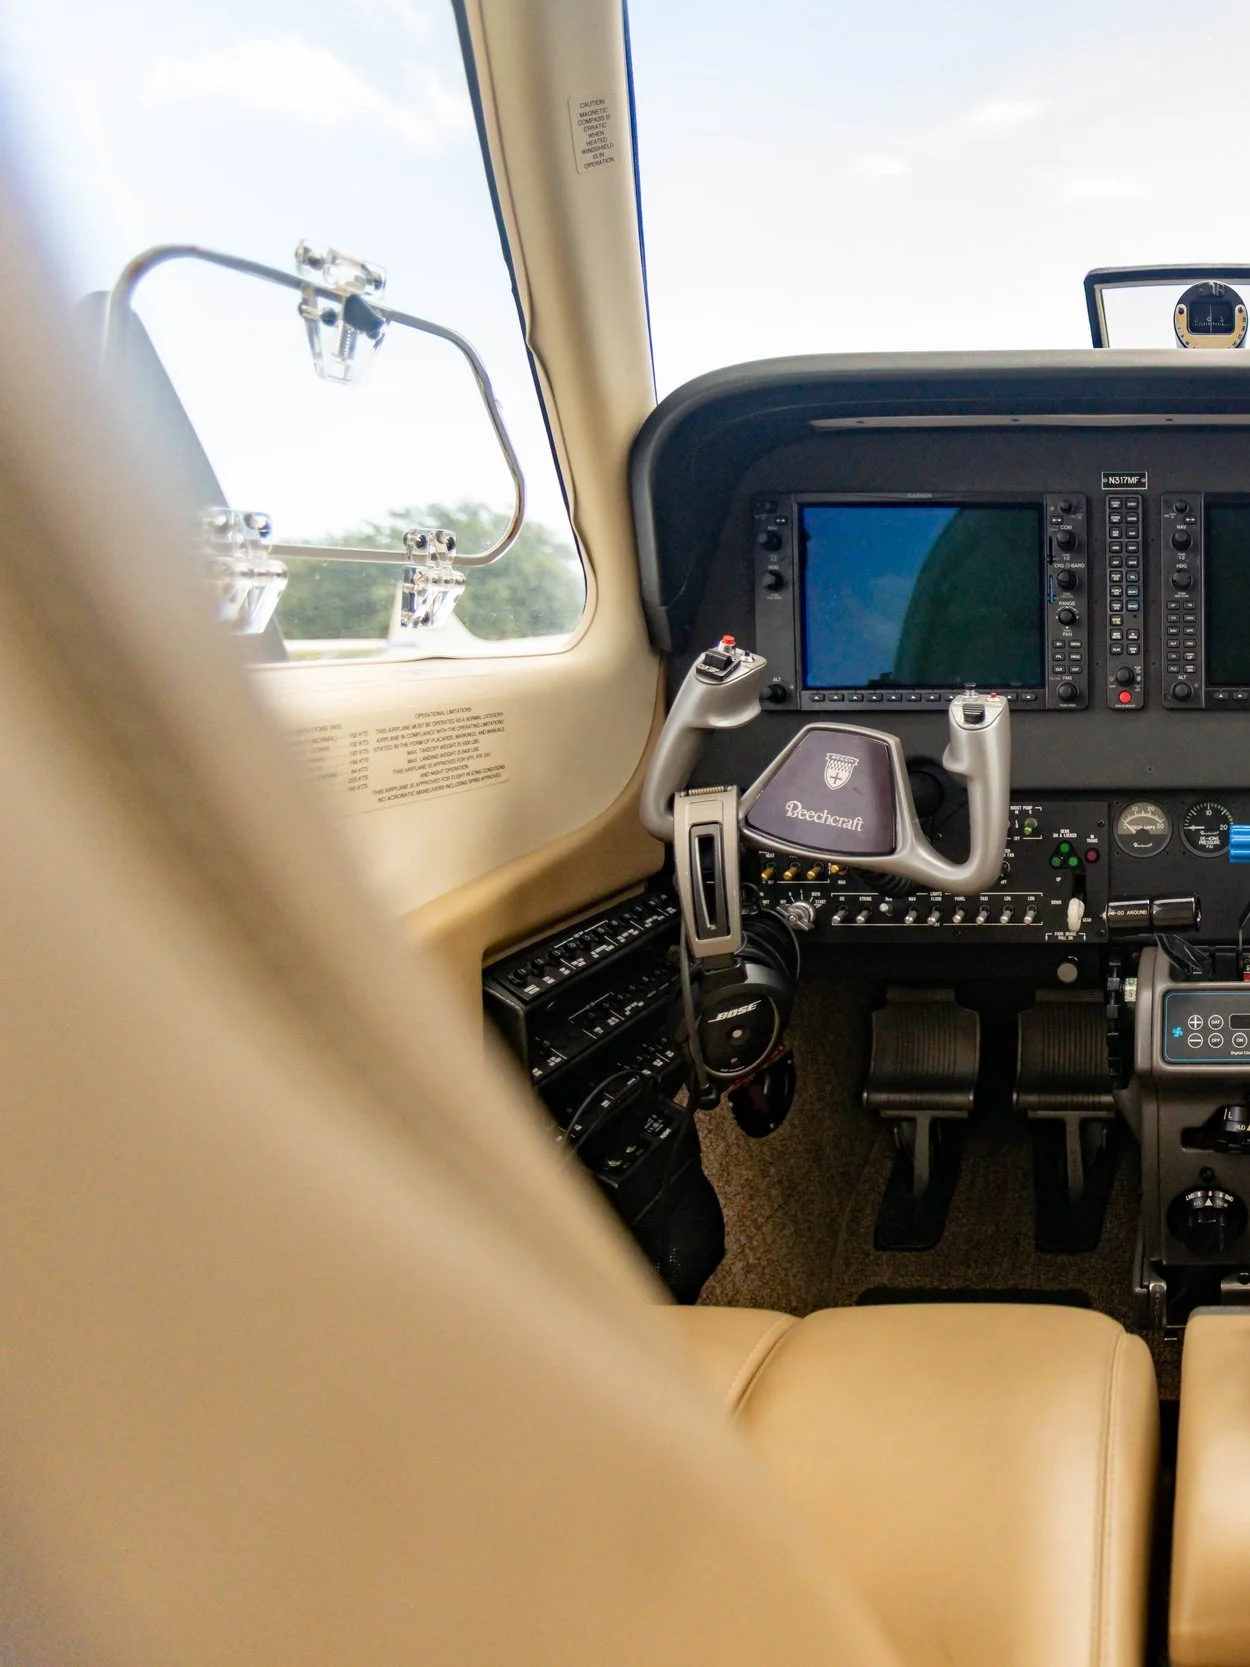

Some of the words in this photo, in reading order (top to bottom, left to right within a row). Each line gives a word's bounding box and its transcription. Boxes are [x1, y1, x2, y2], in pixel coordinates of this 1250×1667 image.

[580, 99, 605, 108] CAUTION
[579, 107, 608, 118] MAGNETIC
[577, 115, 605, 126] COMPASS
[584, 122, 607, 132] ERRATIC
[586, 137, 607, 147] HEATED
[581, 143, 614, 155] WINDSHIELD
[584, 157, 614, 169] OPERATION
[1108, 476, 1140, 485] N317MF
[415, 710, 445, 719] OPERATIONAL
[447, 707, 472, 715] LIMITATIONS
[483, 711, 504, 719] CATEGORY
[376, 734, 400, 743] AIRPLANE
[406, 729, 435, 739] COMPLIANCE
[420, 754, 439, 762] LANDING
[831, 755, 854, 763] BEECH
[405, 764, 426, 772] AIRPLANE
[385, 784, 408, 793] AIRPLANE
[416, 778, 440, 787] APPROVED
[387, 791, 415, 800] ACROBATIC
[416, 785, 444, 795] MANEUVERS
[445, 780, 468, 789] INCLUDING
[785, 800, 864, 831] Beechcraft
[711, 1001, 760, 1021] BOSE
